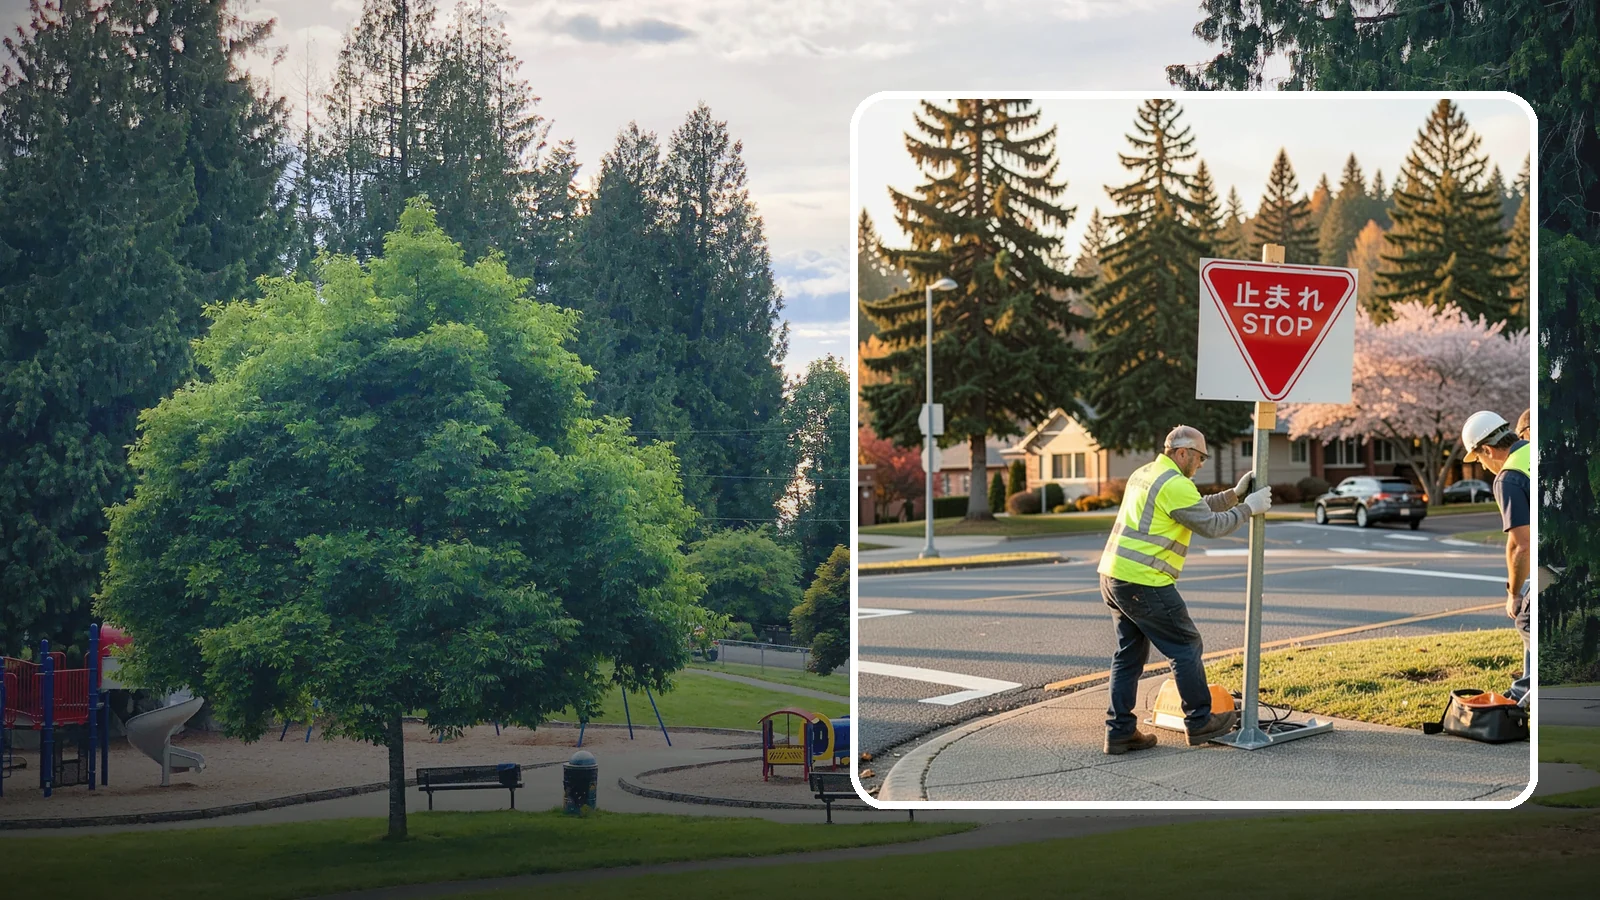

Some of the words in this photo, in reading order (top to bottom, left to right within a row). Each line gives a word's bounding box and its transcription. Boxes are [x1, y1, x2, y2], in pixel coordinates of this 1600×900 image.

[1233, 281, 1324, 311] 止まれ
[1242, 313, 1313, 336] STOP
